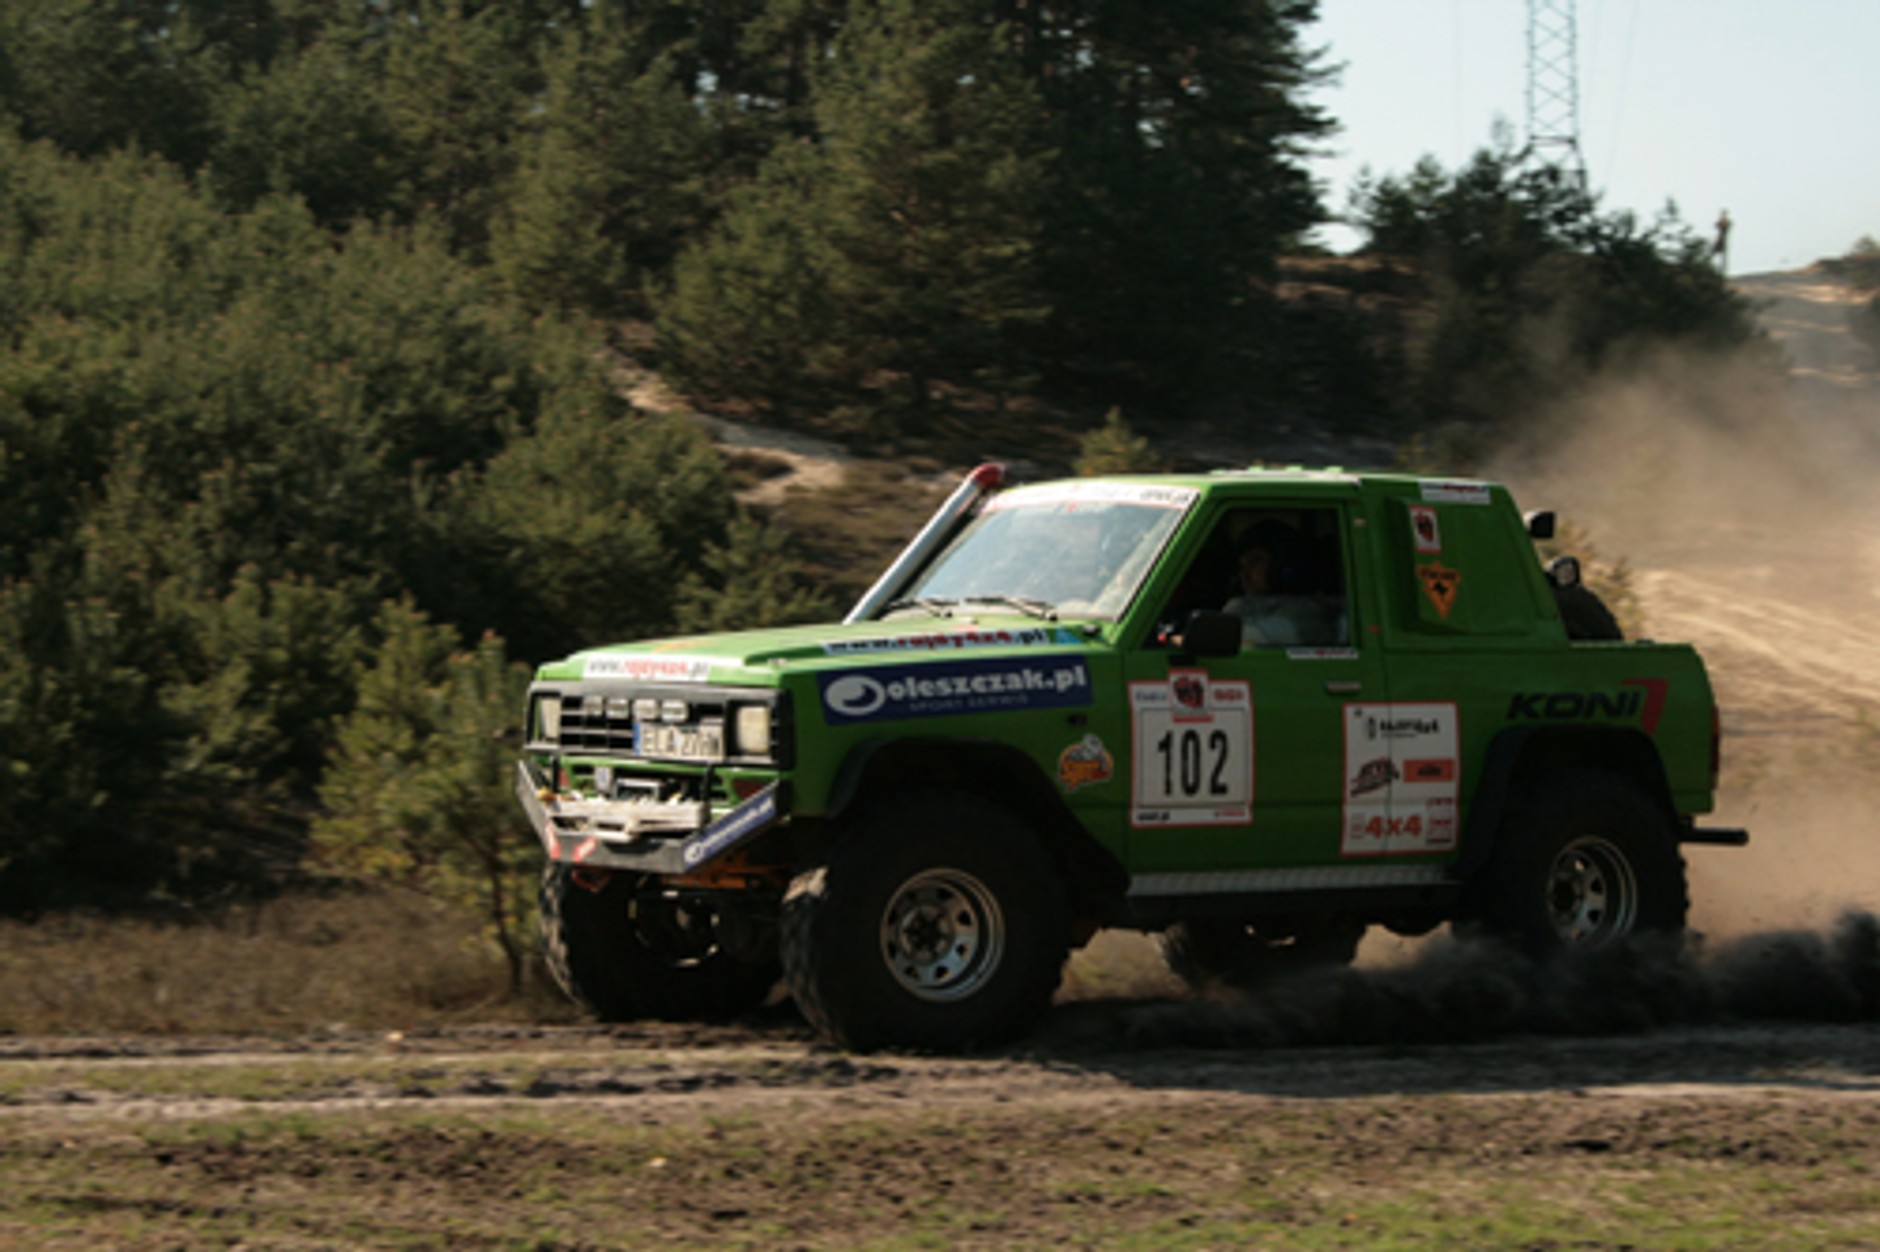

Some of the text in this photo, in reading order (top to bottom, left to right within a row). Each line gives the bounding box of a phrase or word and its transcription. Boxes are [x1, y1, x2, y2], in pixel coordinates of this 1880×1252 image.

[887, 665, 1086, 699] oleszczak.pl
[1506, 691, 1643, 720] KONI
[1157, 728, 1230, 797] 102
[1365, 814, 1423, 839] 4x4
